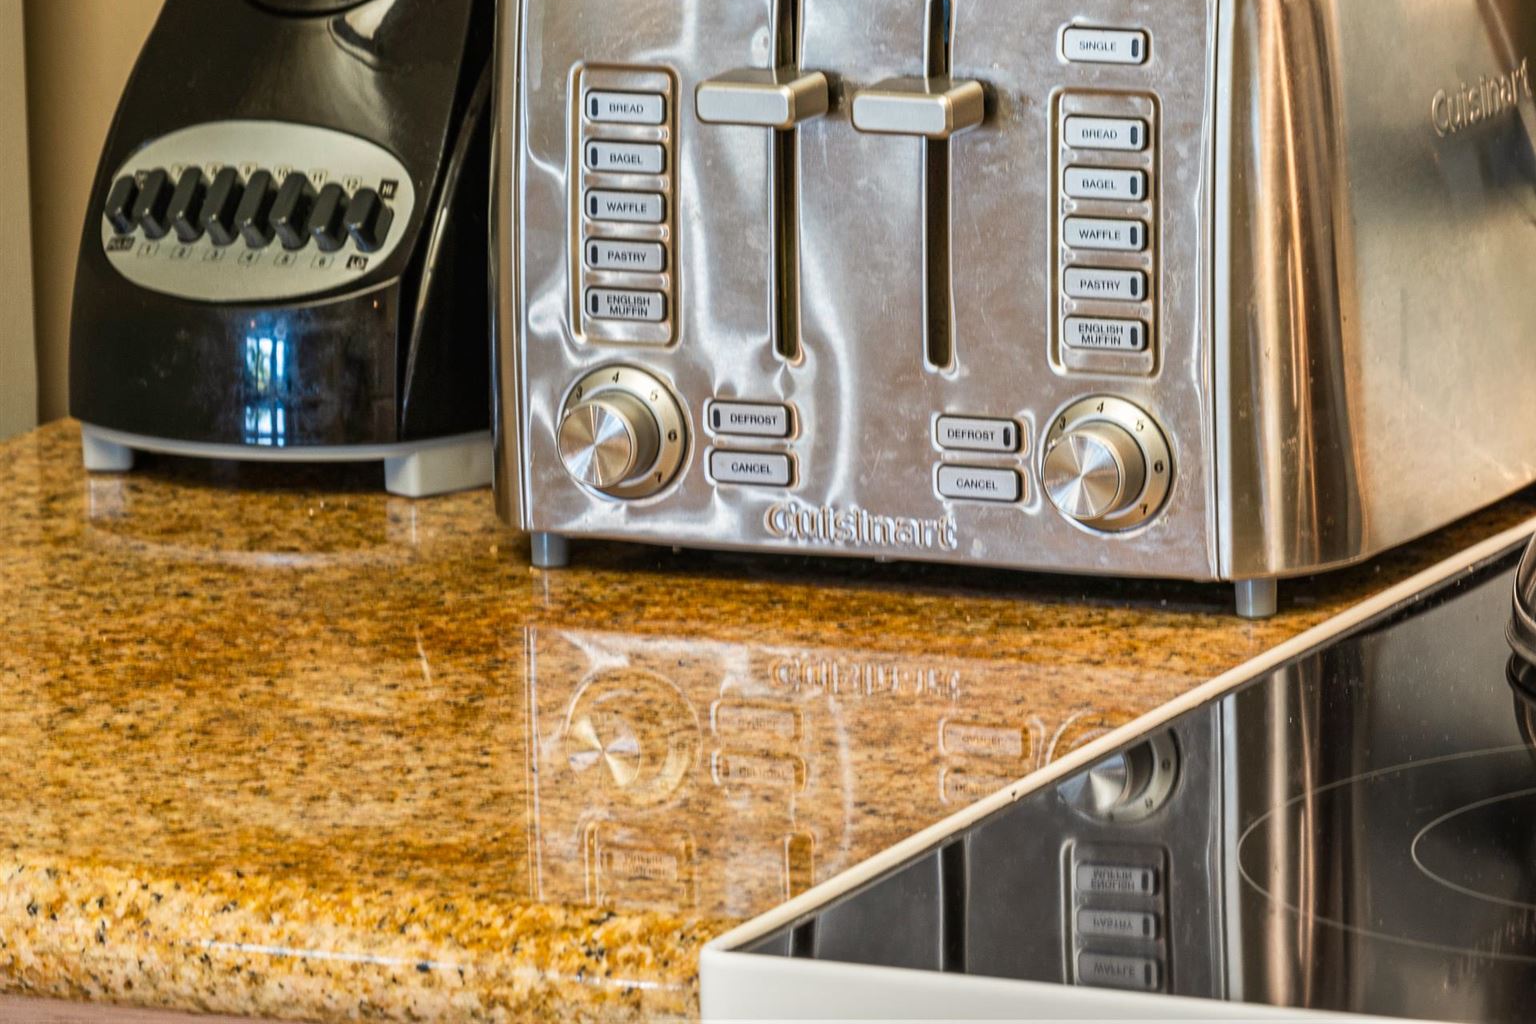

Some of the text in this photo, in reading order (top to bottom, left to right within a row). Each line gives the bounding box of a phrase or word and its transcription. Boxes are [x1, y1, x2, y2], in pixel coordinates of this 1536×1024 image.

[1080, 41, 1116, 52] SINGLE
[1432, 57, 1532, 137] Cuisinart
[609, 103, 644, 114] BREAD
[1081, 128, 1118, 139] BREAD
[609, 153, 643, 165] BAGEL
[1082, 178, 1117, 190] BAGEL
[607, 201, 647, 213] WAFFLE
[1079, 229, 1121, 241] WAFFLE
[608, 251, 646, 262] PASTRY
[1080, 279, 1120, 291] PASTRY
[607, 295, 650, 306] ENGLISH
[610, 306, 648, 316] MUFFIN
[1078, 322, 1124, 335] ENGLISH
[1081, 334, 1121, 345] MUFFIN
[612, 371, 620, 383] 4
[650, 389, 659, 401] 5
[1096, 402, 1105, 413] 4
[730, 413, 777, 426] DEFROST
[1136, 419, 1145, 431] 5
[668, 429, 677, 443] 6
[947, 428, 995, 441] DEFROST
[731, 462, 773, 475] CANCEL
[1154, 460, 1164, 474] 6
[654, 471, 663, 483] 7
[956, 478, 998, 491] CANCEL
[1140, 503, 1148, 515] 7
[764, 502, 957, 549] Cuisinart
